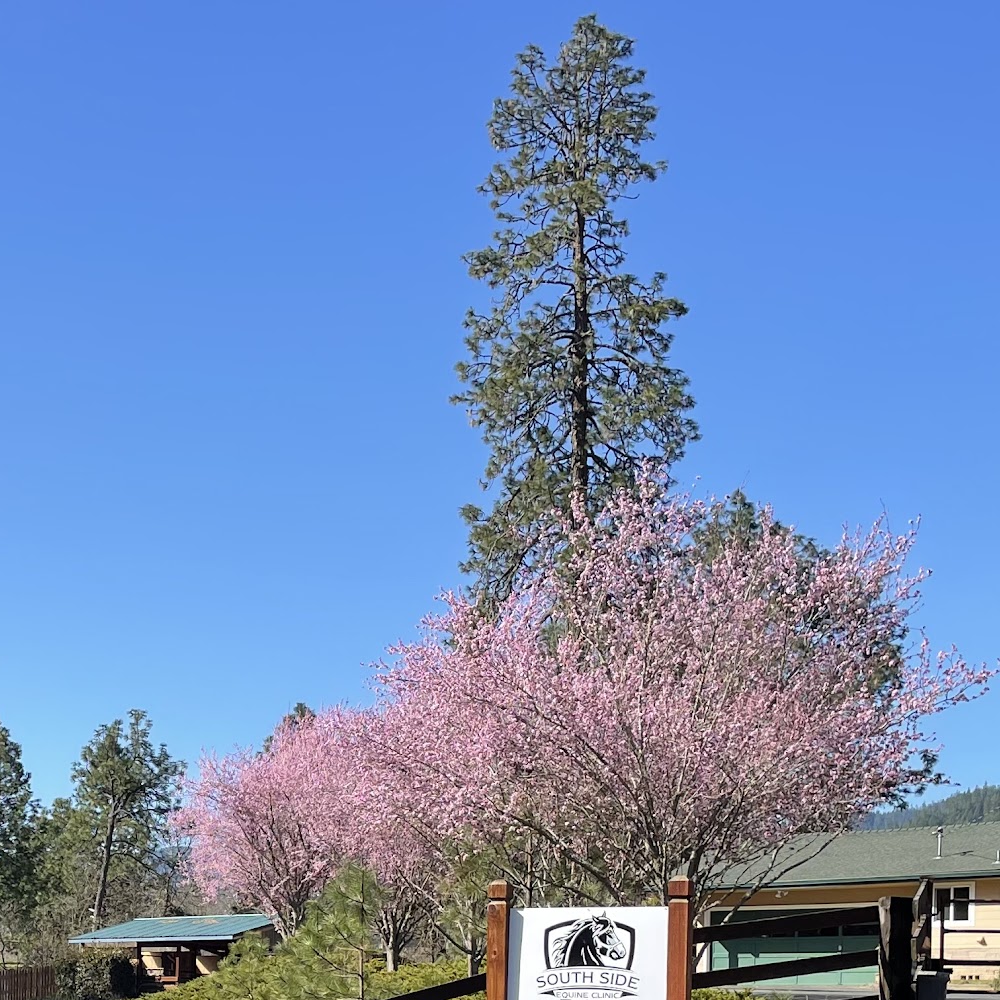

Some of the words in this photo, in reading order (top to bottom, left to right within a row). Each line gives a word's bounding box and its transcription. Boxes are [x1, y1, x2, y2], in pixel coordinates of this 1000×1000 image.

[536, 971, 593, 988] SOUTH
[599, 971, 640, 989] SIDE
[556, 991, 588, 999] EQUINE
[591, 991, 620, 999] CLINIC
